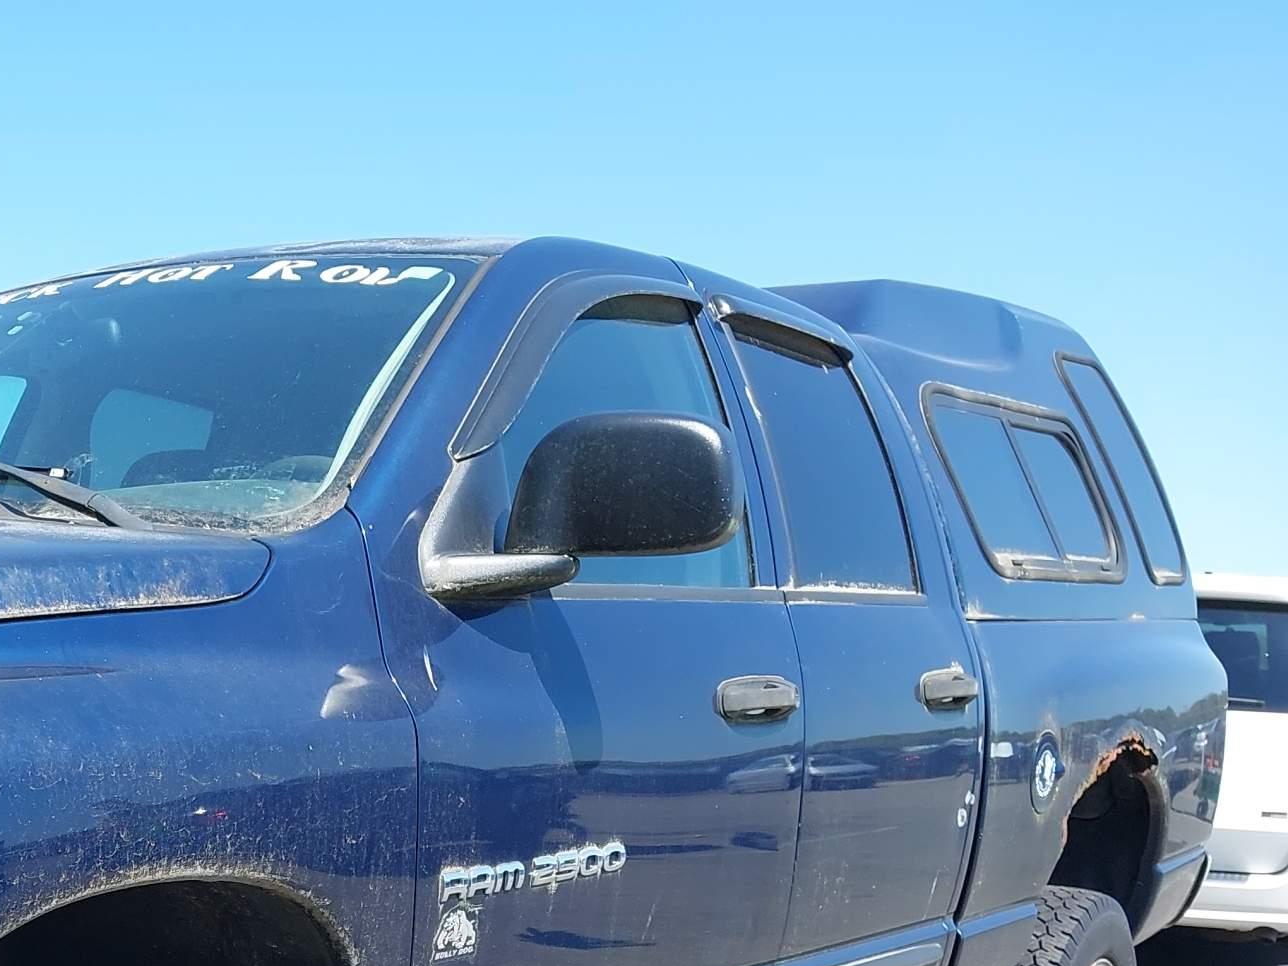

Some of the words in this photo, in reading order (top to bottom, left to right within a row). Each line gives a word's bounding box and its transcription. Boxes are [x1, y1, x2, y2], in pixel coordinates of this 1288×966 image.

[93, 263, 234, 289] HOT
[439, 861, 526, 903] RAM
[529, 841, 627, 888] 2500
